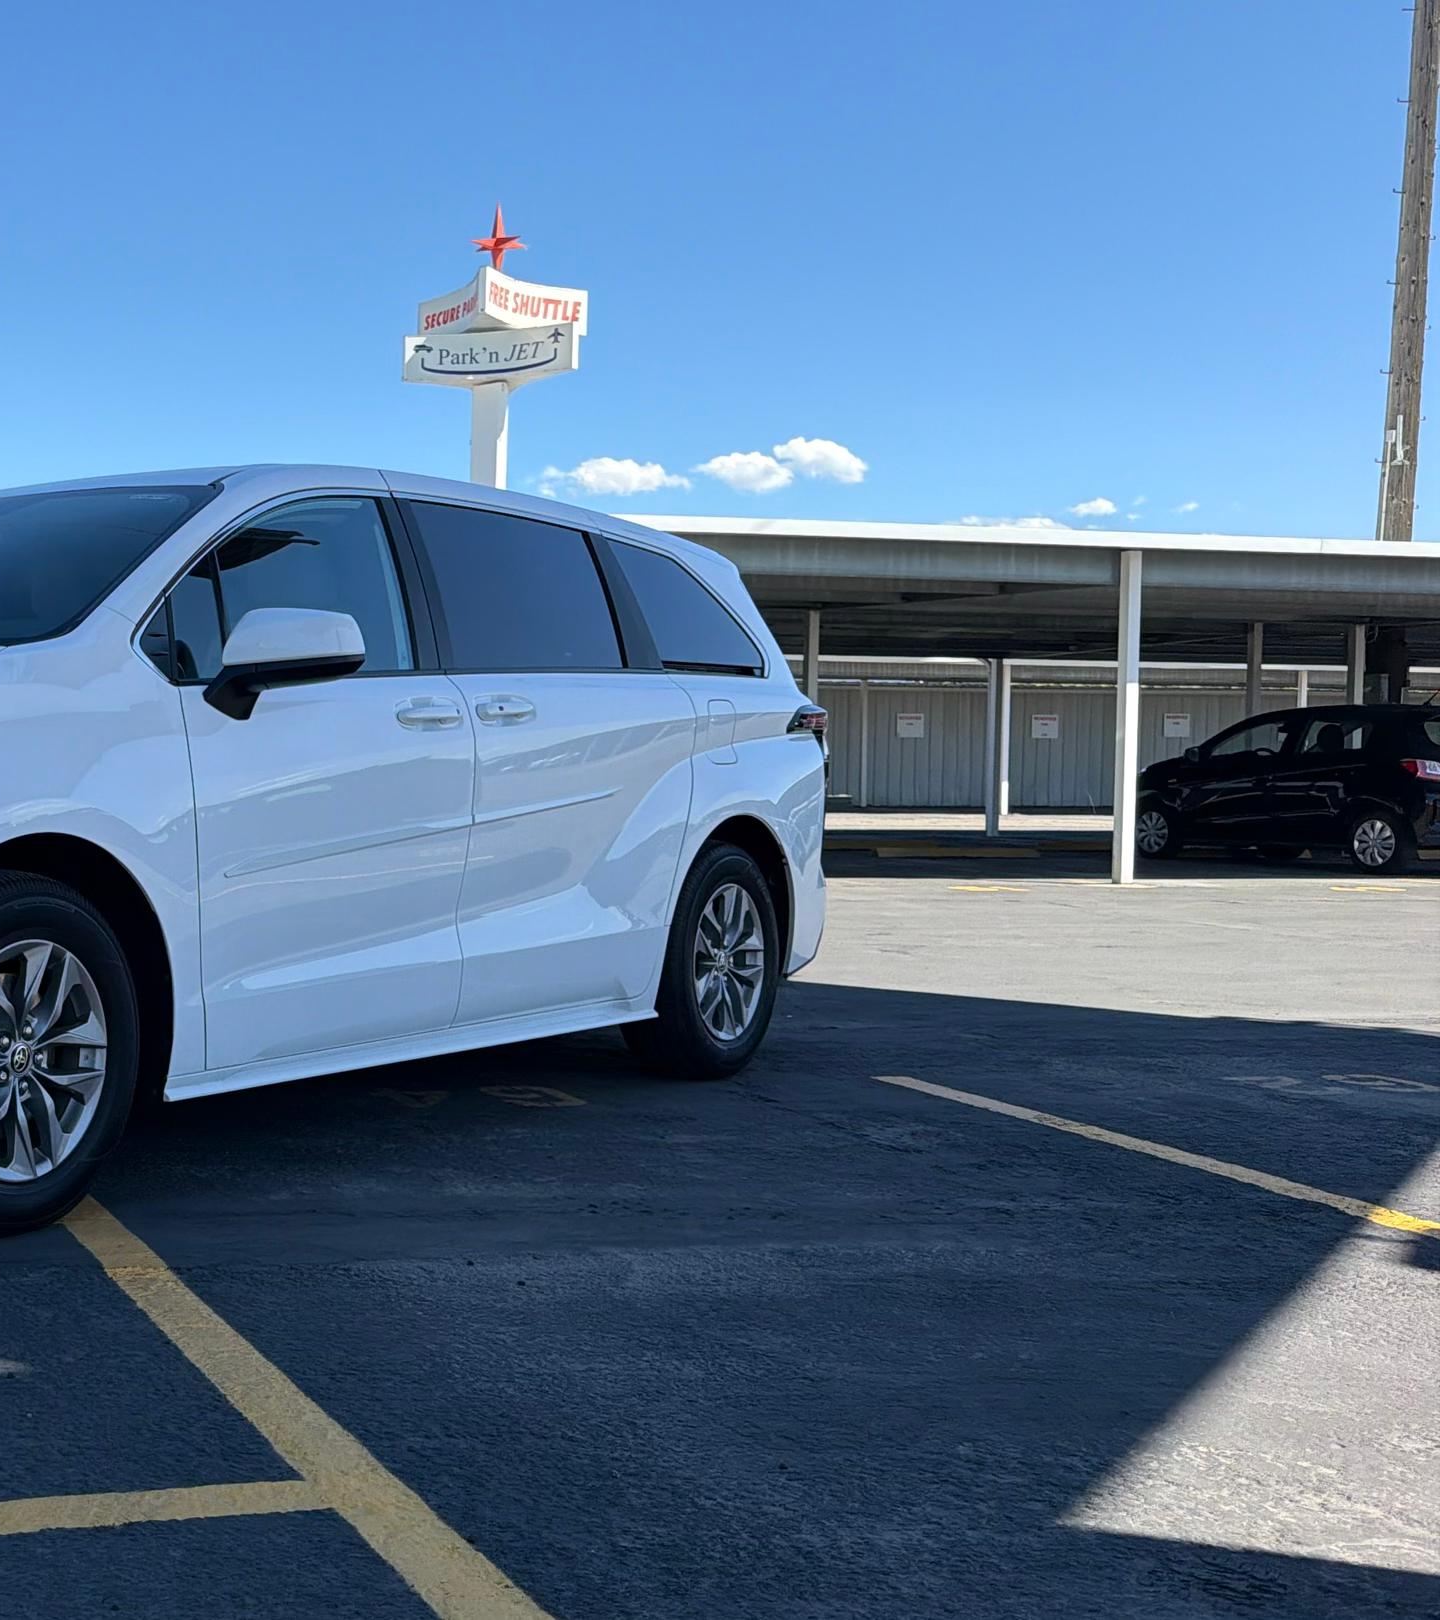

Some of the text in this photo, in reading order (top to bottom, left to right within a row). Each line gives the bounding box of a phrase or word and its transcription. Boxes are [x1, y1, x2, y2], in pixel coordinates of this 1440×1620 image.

[489, 281, 582, 322] FREE SHUTTLE
[423, 304, 460, 331] SECURE
[504, 341, 545, 363] JET
